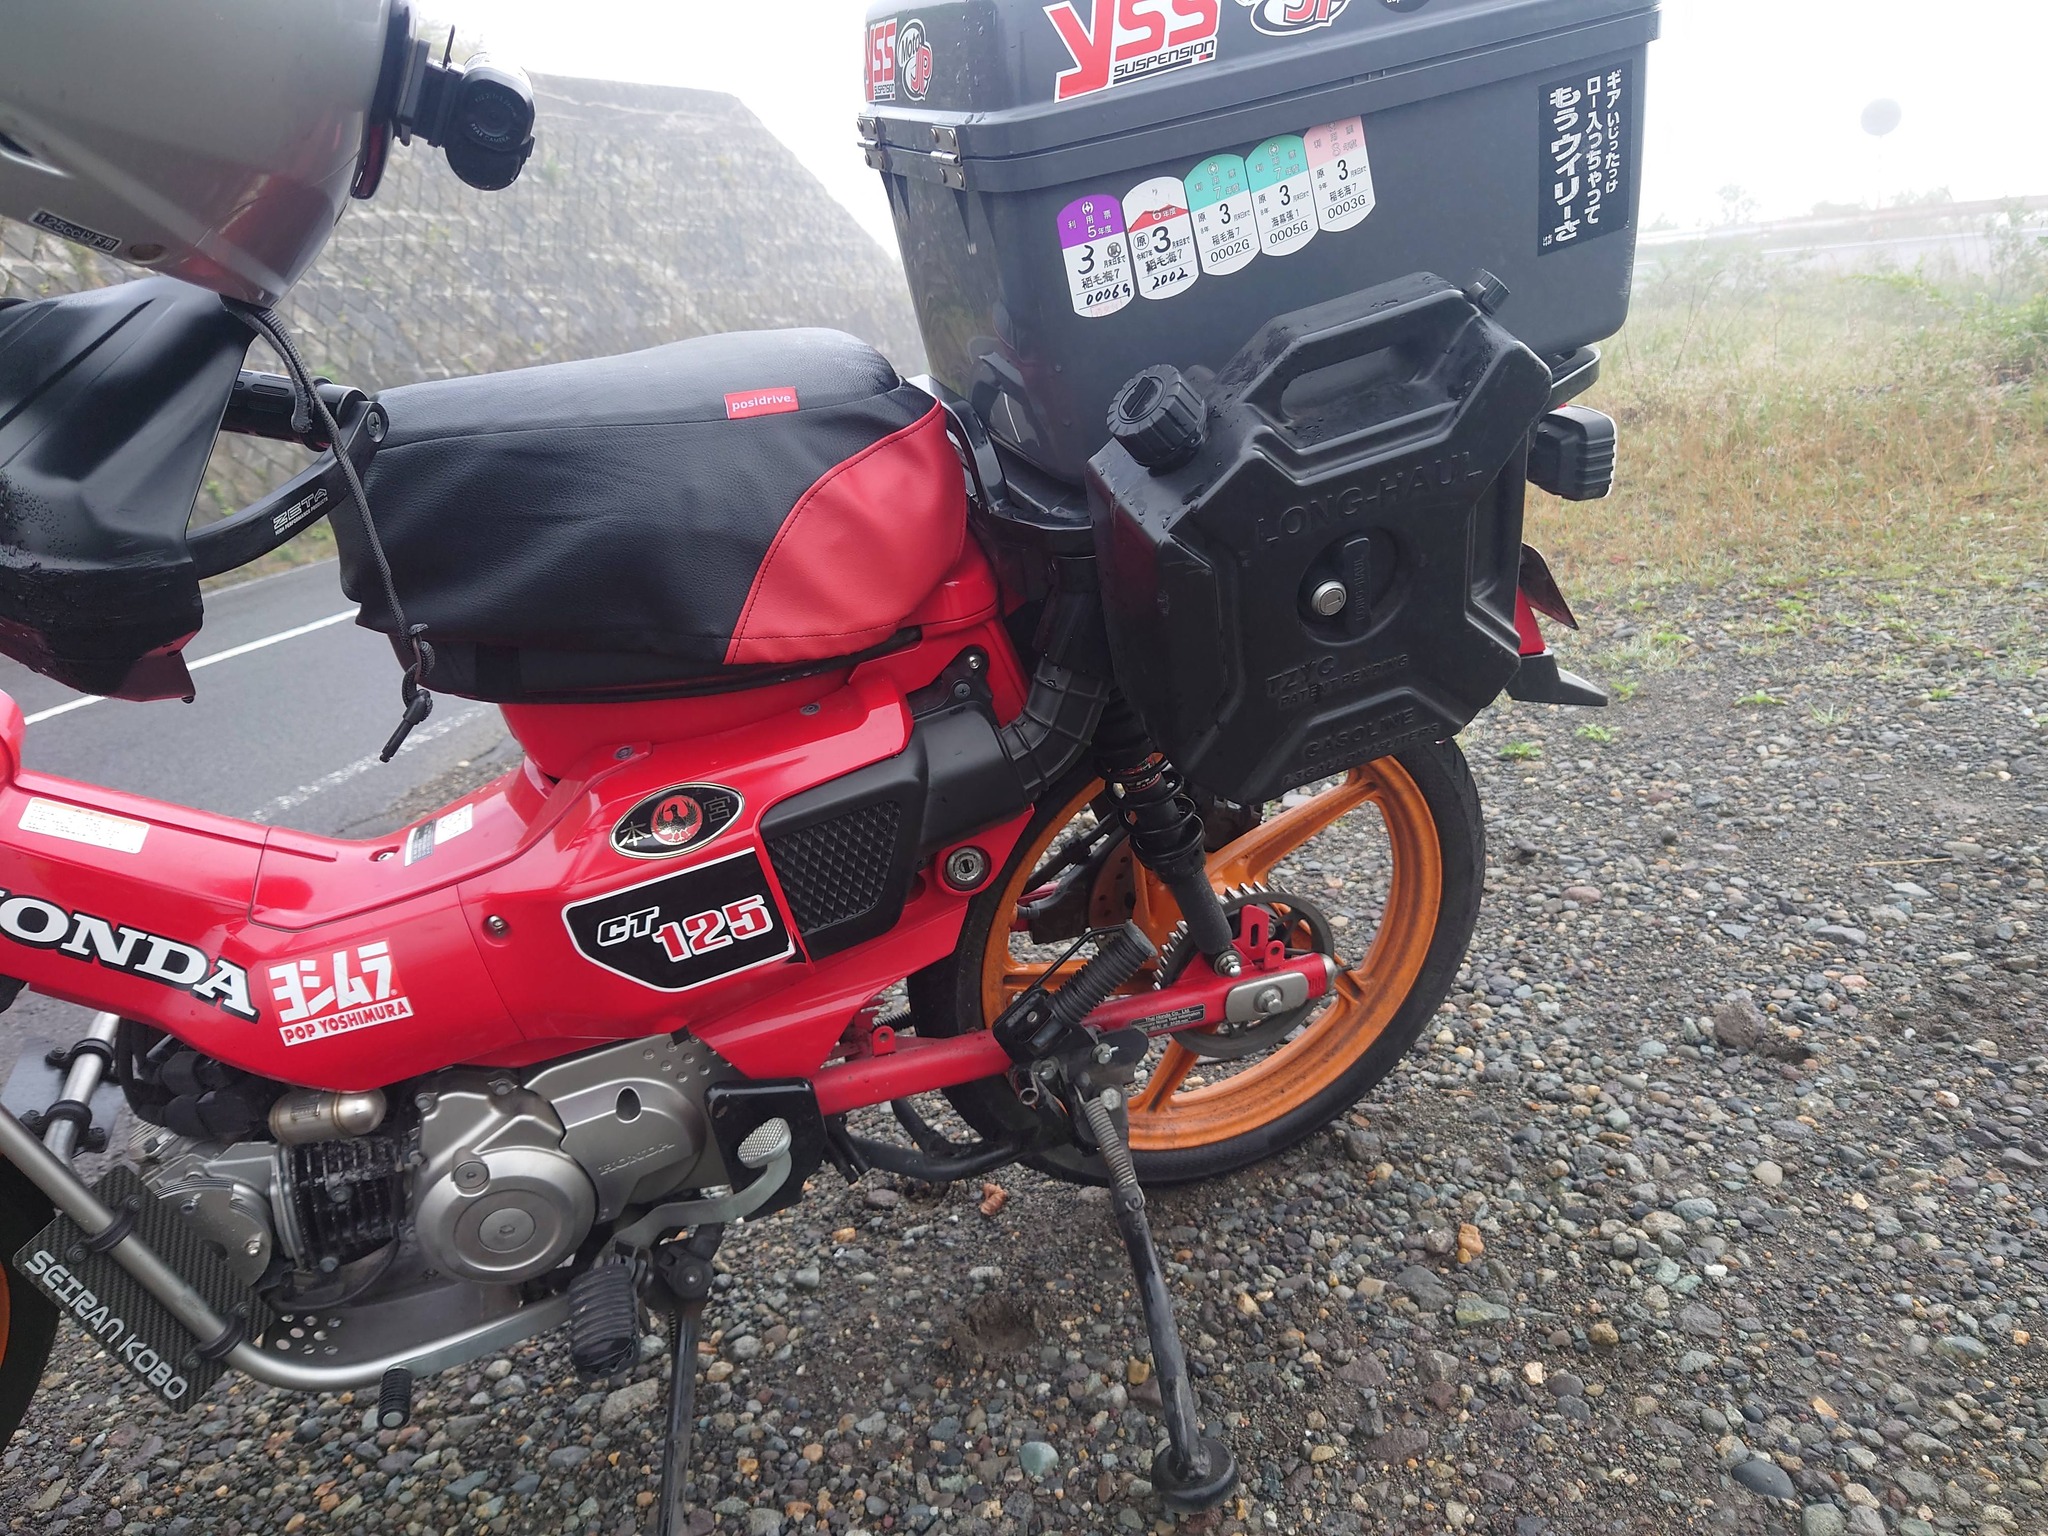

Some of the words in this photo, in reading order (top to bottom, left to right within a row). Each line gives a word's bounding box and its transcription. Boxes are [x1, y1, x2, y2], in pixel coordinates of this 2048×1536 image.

[865, 22, 896, 101] YSS
[900, 32, 921, 65] Moto
[1113, 39, 1215, 78] SUSPENSION
[1337, 159, 1349, 181] 3
[1279, 185, 1291, 206] 3
[1327, 194, 1366, 219] 0003G
[1219, 203, 1231, 224] 3
[1152, 226, 1171, 253] 3
[1269, 220, 1309, 244] 0005G
[1077, 245, 1095, 275] 3
[1210, 239, 1250, 263] 0002G
[1152, 267, 1188, 290] 2002
[731, 394, 791, 413] posidrive
[273, 488, 328, 530] ZETA
[1256, 450, 1483, 543] LONG-HAUL
[1304, 706, 1414, 760] GASOLINE
[597, 905, 660, 947] CT
[652, 894, 774, 963] 125
[0, 889, 256, 1018] ONDA
[268, 940, 394, 1025] ヨシムラ
[284, 1022, 316, 1045] POP
[317, 1000, 409, 1032] YOSHIMURA
[598, 1144, 676, 1176] HONDA
[24, 1250, 125, 1344] SEIRAN
[117, 1333, 188, 1400] KOBO
